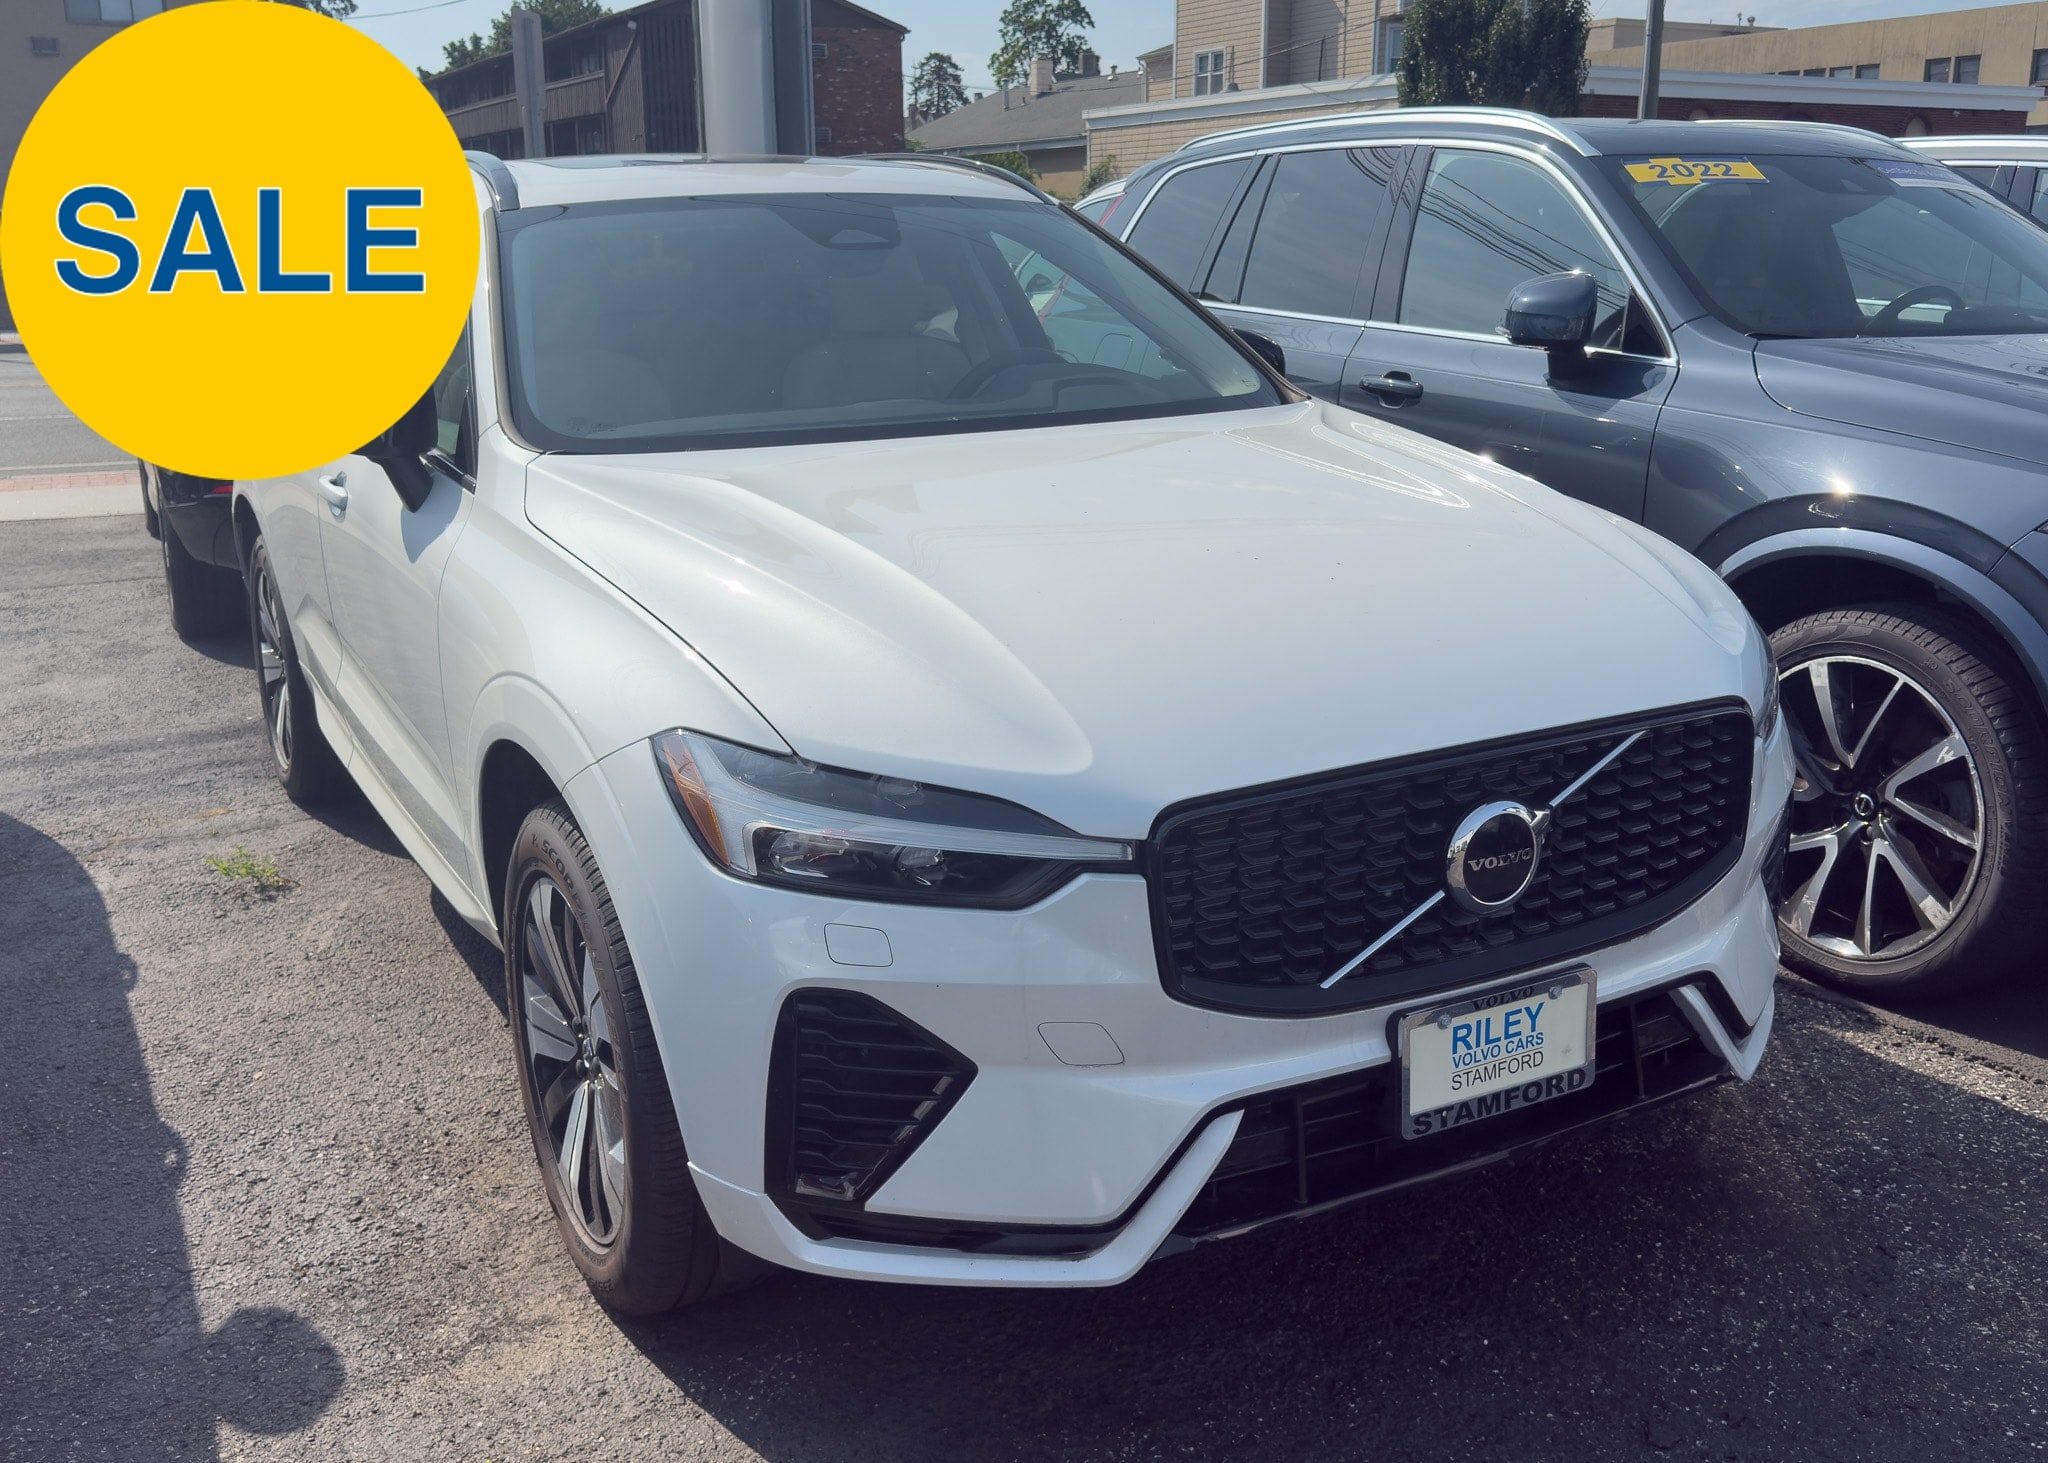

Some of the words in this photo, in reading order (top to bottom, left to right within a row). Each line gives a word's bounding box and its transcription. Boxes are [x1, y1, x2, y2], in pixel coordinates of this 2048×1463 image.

[1649, 163, 1740, 178] 2022
[1468, 848, 1532, 872] VOLVO
[1472, 986, 1534, 1011] VOLVO
[1452, 1002, 1545, 1054] RILEY
[1452, 1044, 1501, 1069] VOLVO
[1505, 1032, 1544, 1053] CARS
[1451, 1050, 1544, 1091] STAMFORD
[1412, 1069, 1586, 1135] STAMFORD
